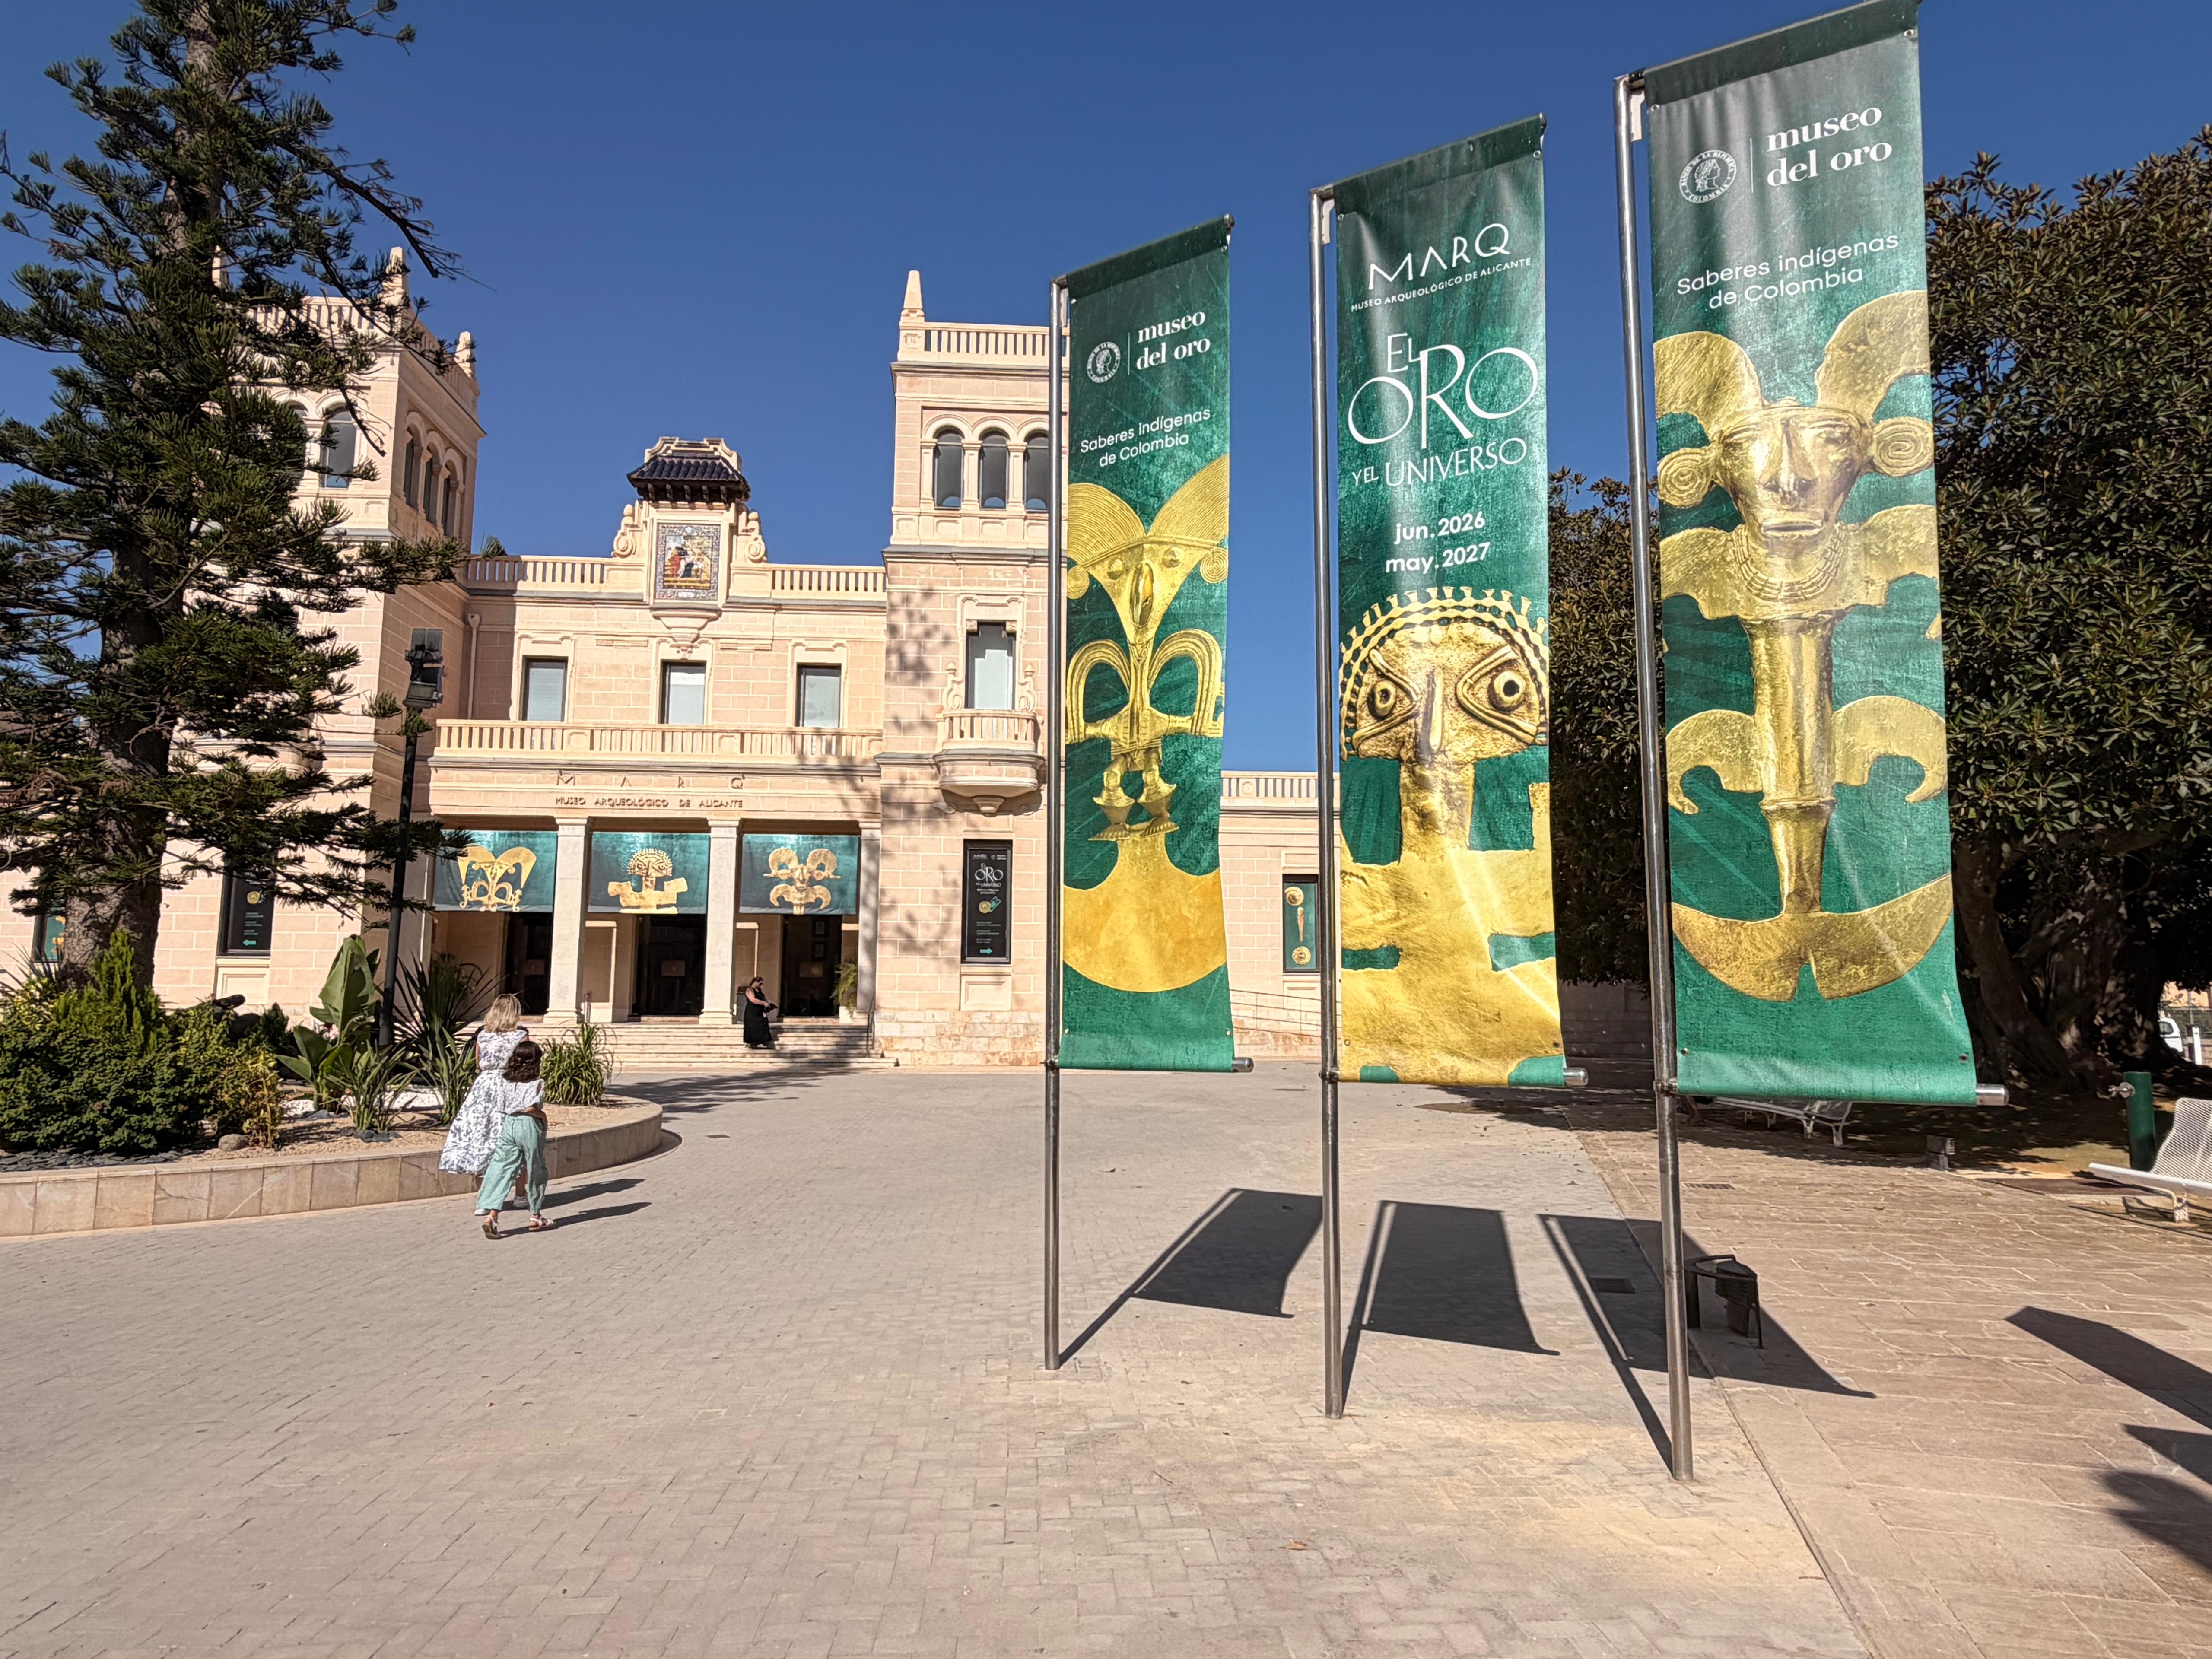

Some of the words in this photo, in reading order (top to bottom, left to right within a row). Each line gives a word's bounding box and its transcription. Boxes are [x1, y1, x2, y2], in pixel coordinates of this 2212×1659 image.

[1767, 107, 1882, 152] museo
[1767, 150, 1818, 187] del
[1830, 143, 1892, 171] oro
[1368, 223, 1510, 290] MARQ
[1677, 261, 1769, 295] Saberes
[1778, 235, 1899, 272] indígenas
[1351, 298, 1382, 312] MUSEO
[1384, 276, 1462, 305] ARQUEOLÓGICO
[1465, 271, 1478, 282] DE
[1480, 257, 1532, 277] ALICANTE
[1709, 290, 1737, 310] de
[1745, 268, 1863, 302] Colombia
[1137, 311, 1205, 343] museo
[1136, 342, 1166, 370] del
[1174, 338, 1211, 360] oro
[1387, 332, 1422, 373] EL
[1348, 344, 1538, 450] ORO
[1080, 427, 1134, 453] Saberes
[1138, 408, 1211, 437] indígenas
[1099, 451, 1116, 467] de
[1119, 432, 1189, 461] Colombia
[1385, 437, 1527, 487] UNIVERSO
[556, 796, 586, 805] MUSEO
[679, 799, 691, 807] DE
[699, 800, 743, 808] ALICANTE
[975, 866, 1003, 882] ORO
